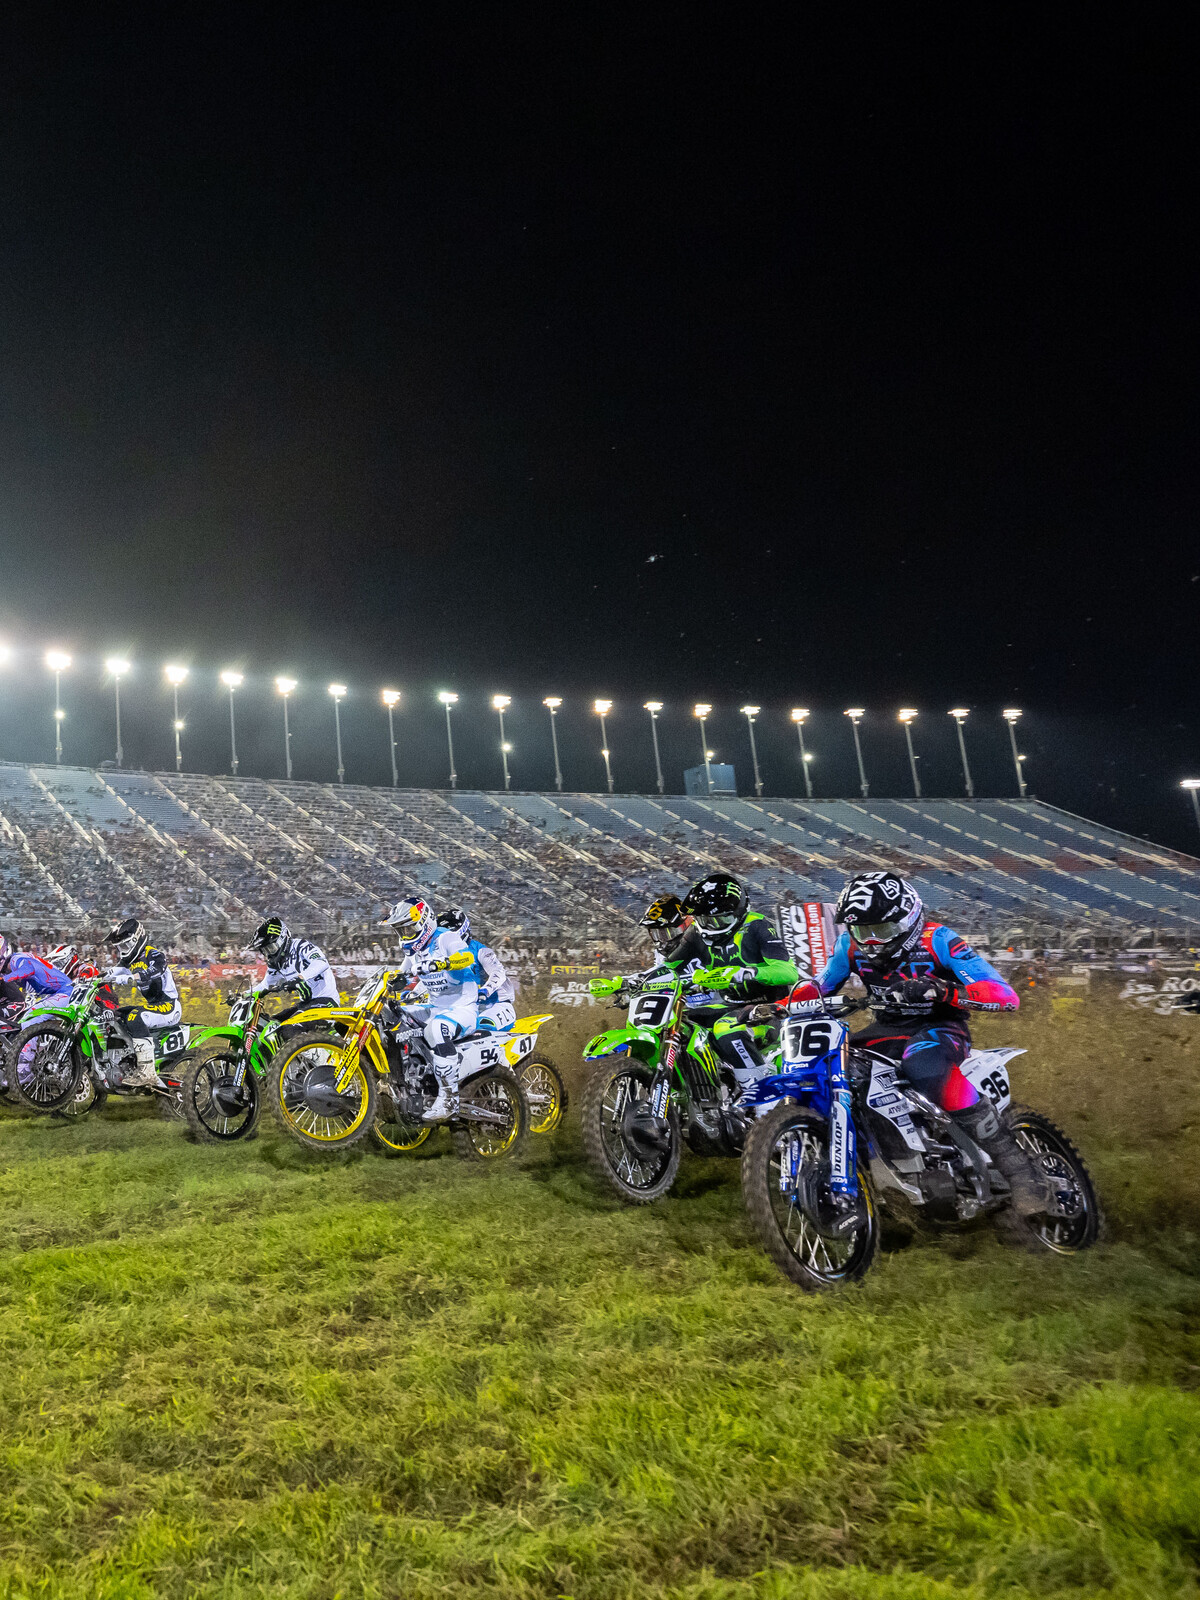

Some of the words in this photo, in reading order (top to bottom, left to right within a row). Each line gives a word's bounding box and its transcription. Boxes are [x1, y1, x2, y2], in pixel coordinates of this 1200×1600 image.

[230, 1002, 250, 1022] 21
[633, 995, 671, 1027] 9
[166, 1032, 185, 1051] 81
[519, 1036, 532, 1054] 47
[734, 1040, 750, 1060] FOX
[781, 1022, 832, 1060] 36
[481, 1047, 499, 1065] 94
[659, 1079, 670, 1119] DUNLOP
[980, 1070, 1010, 1106] 36
[834, 1122, 843, 1174] DUNLOP
